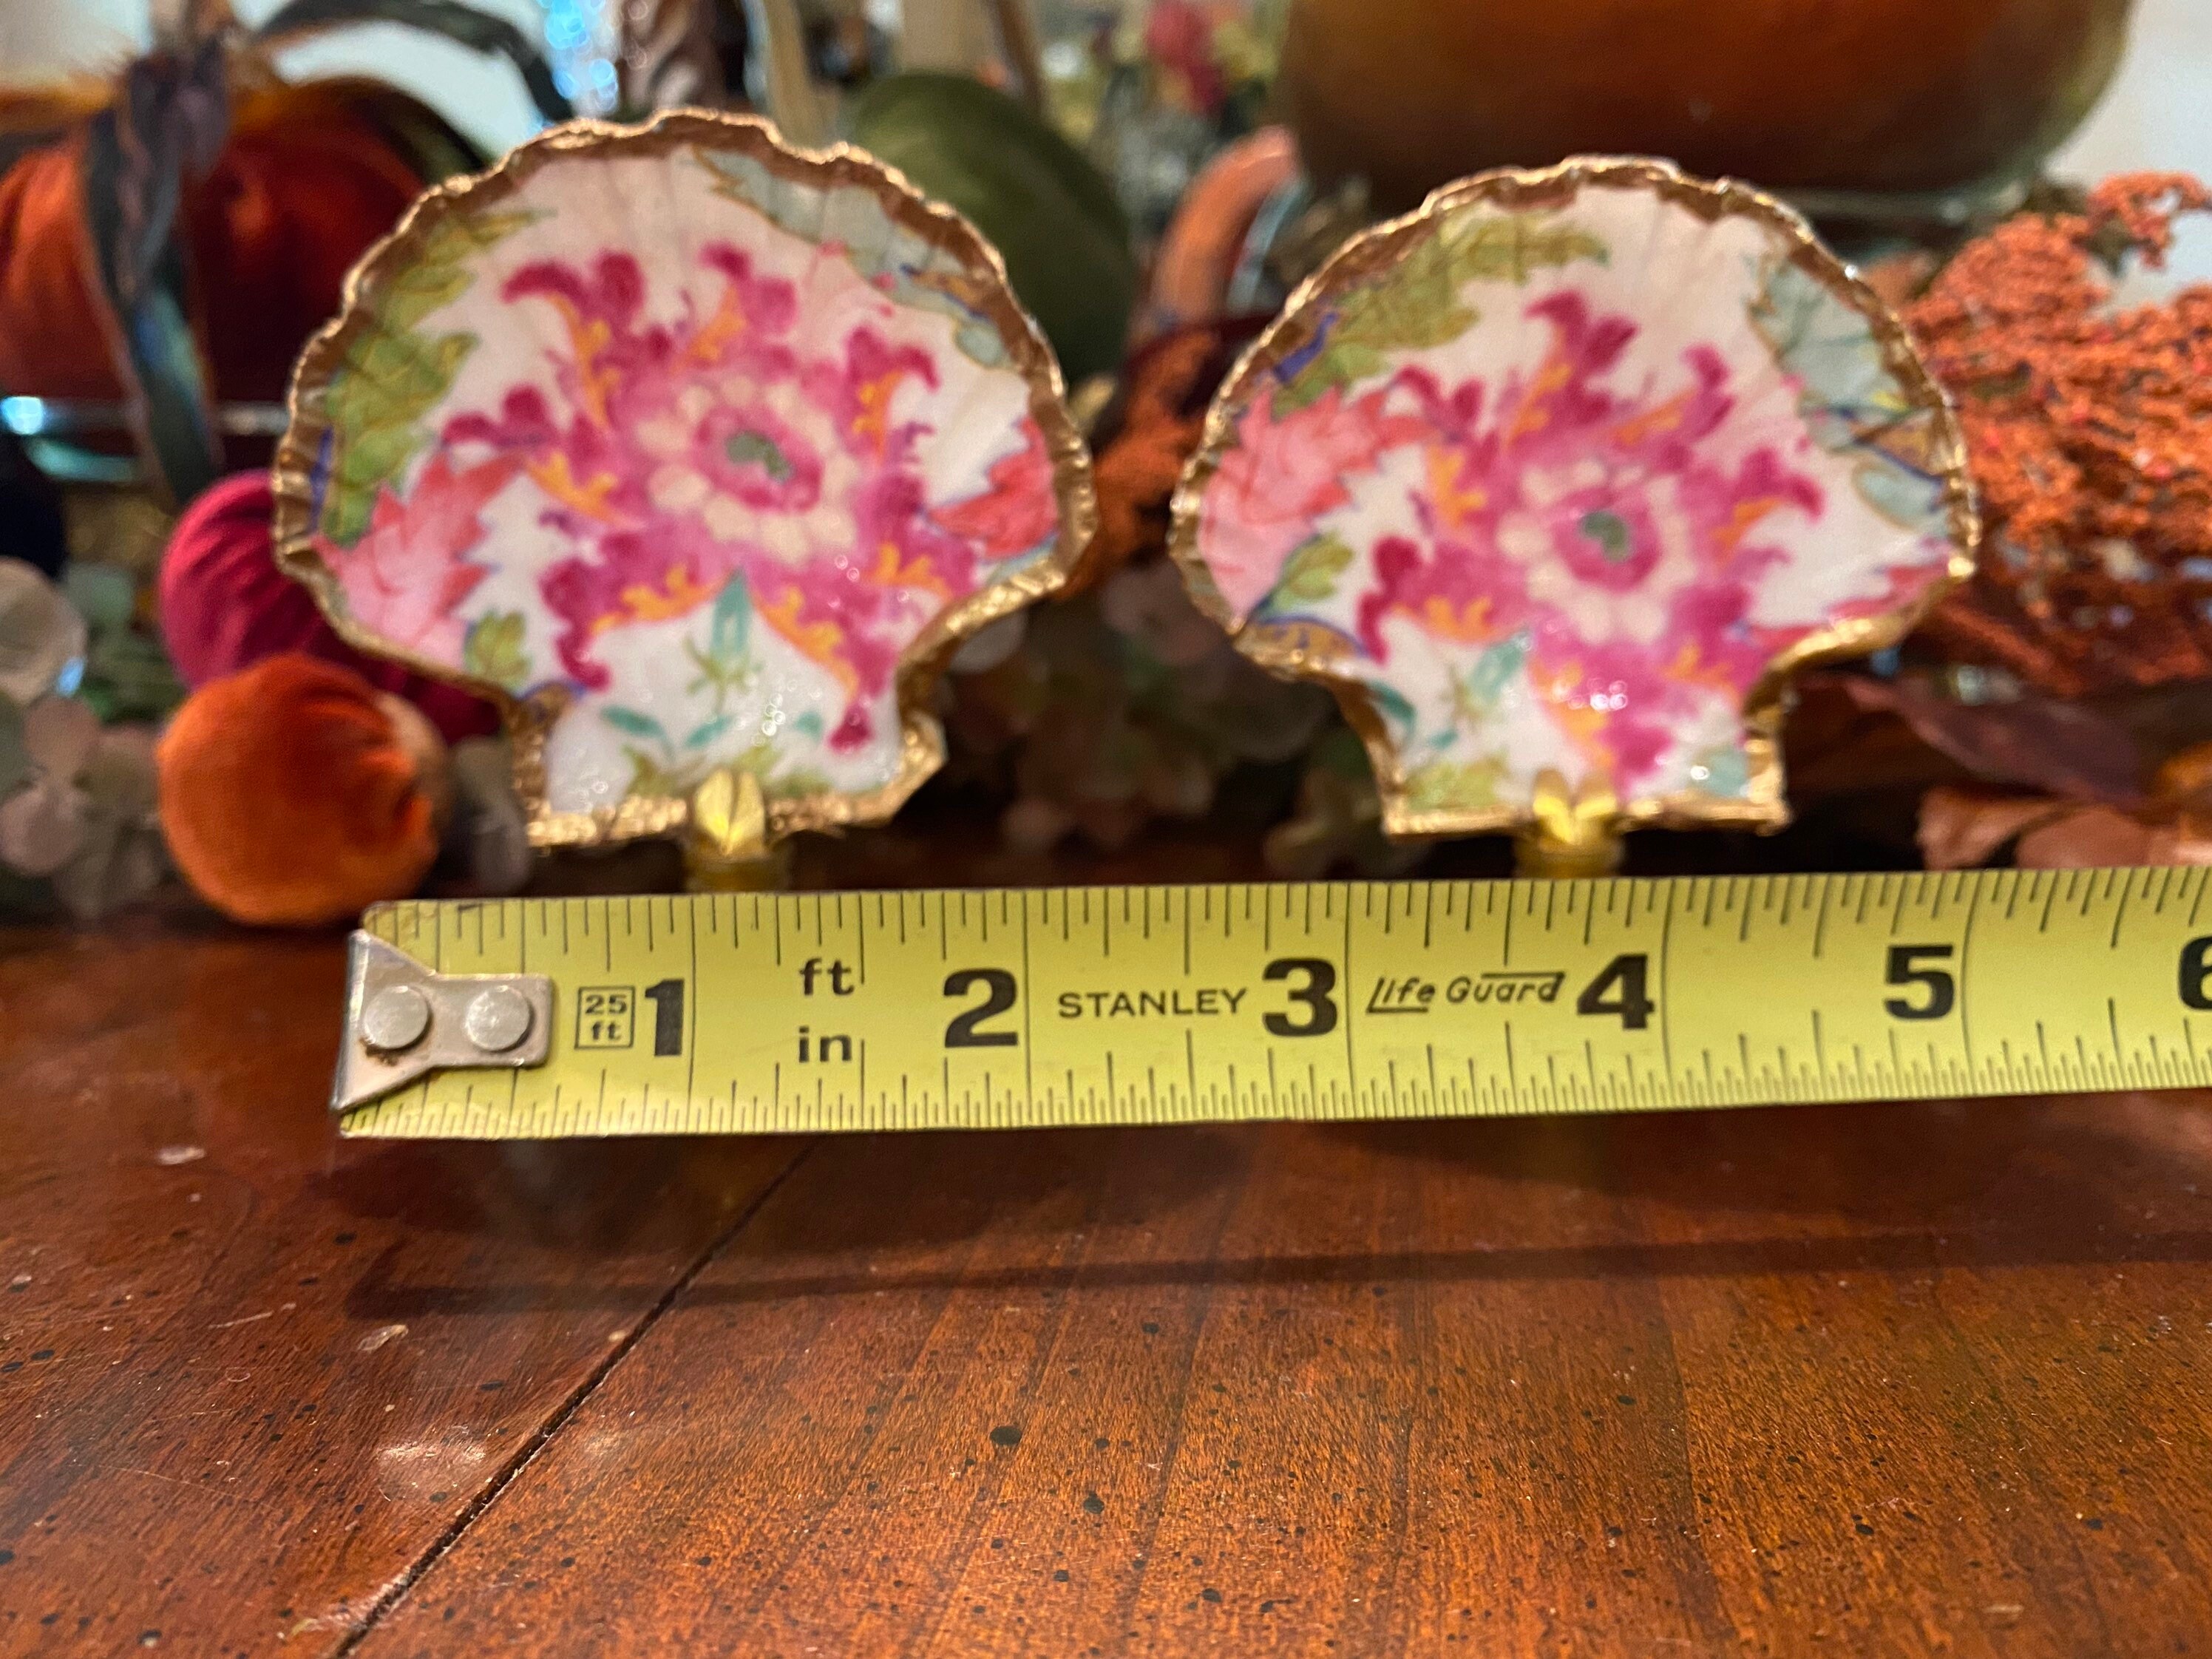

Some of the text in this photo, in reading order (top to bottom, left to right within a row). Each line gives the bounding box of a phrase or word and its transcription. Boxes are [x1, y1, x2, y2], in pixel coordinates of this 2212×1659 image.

[800, 958, 855, 996] ft
[1262, 957, 1337, 1037] 3
[1367, 971, 1565, 1014] Life Guard
[1576, 953, 1656, 1030] 4
[1883, 944, 1955, 1020] 5
[584, 993, 627, 1016] 25
[645, 979, 685, 1056] 1
[943, 968, 1019, 1048] 2
[1058, 988, 1248, 1020] STANLEY
[591, 1022, 621, 1042] ft
[798, 1027, 852, 1063] in
